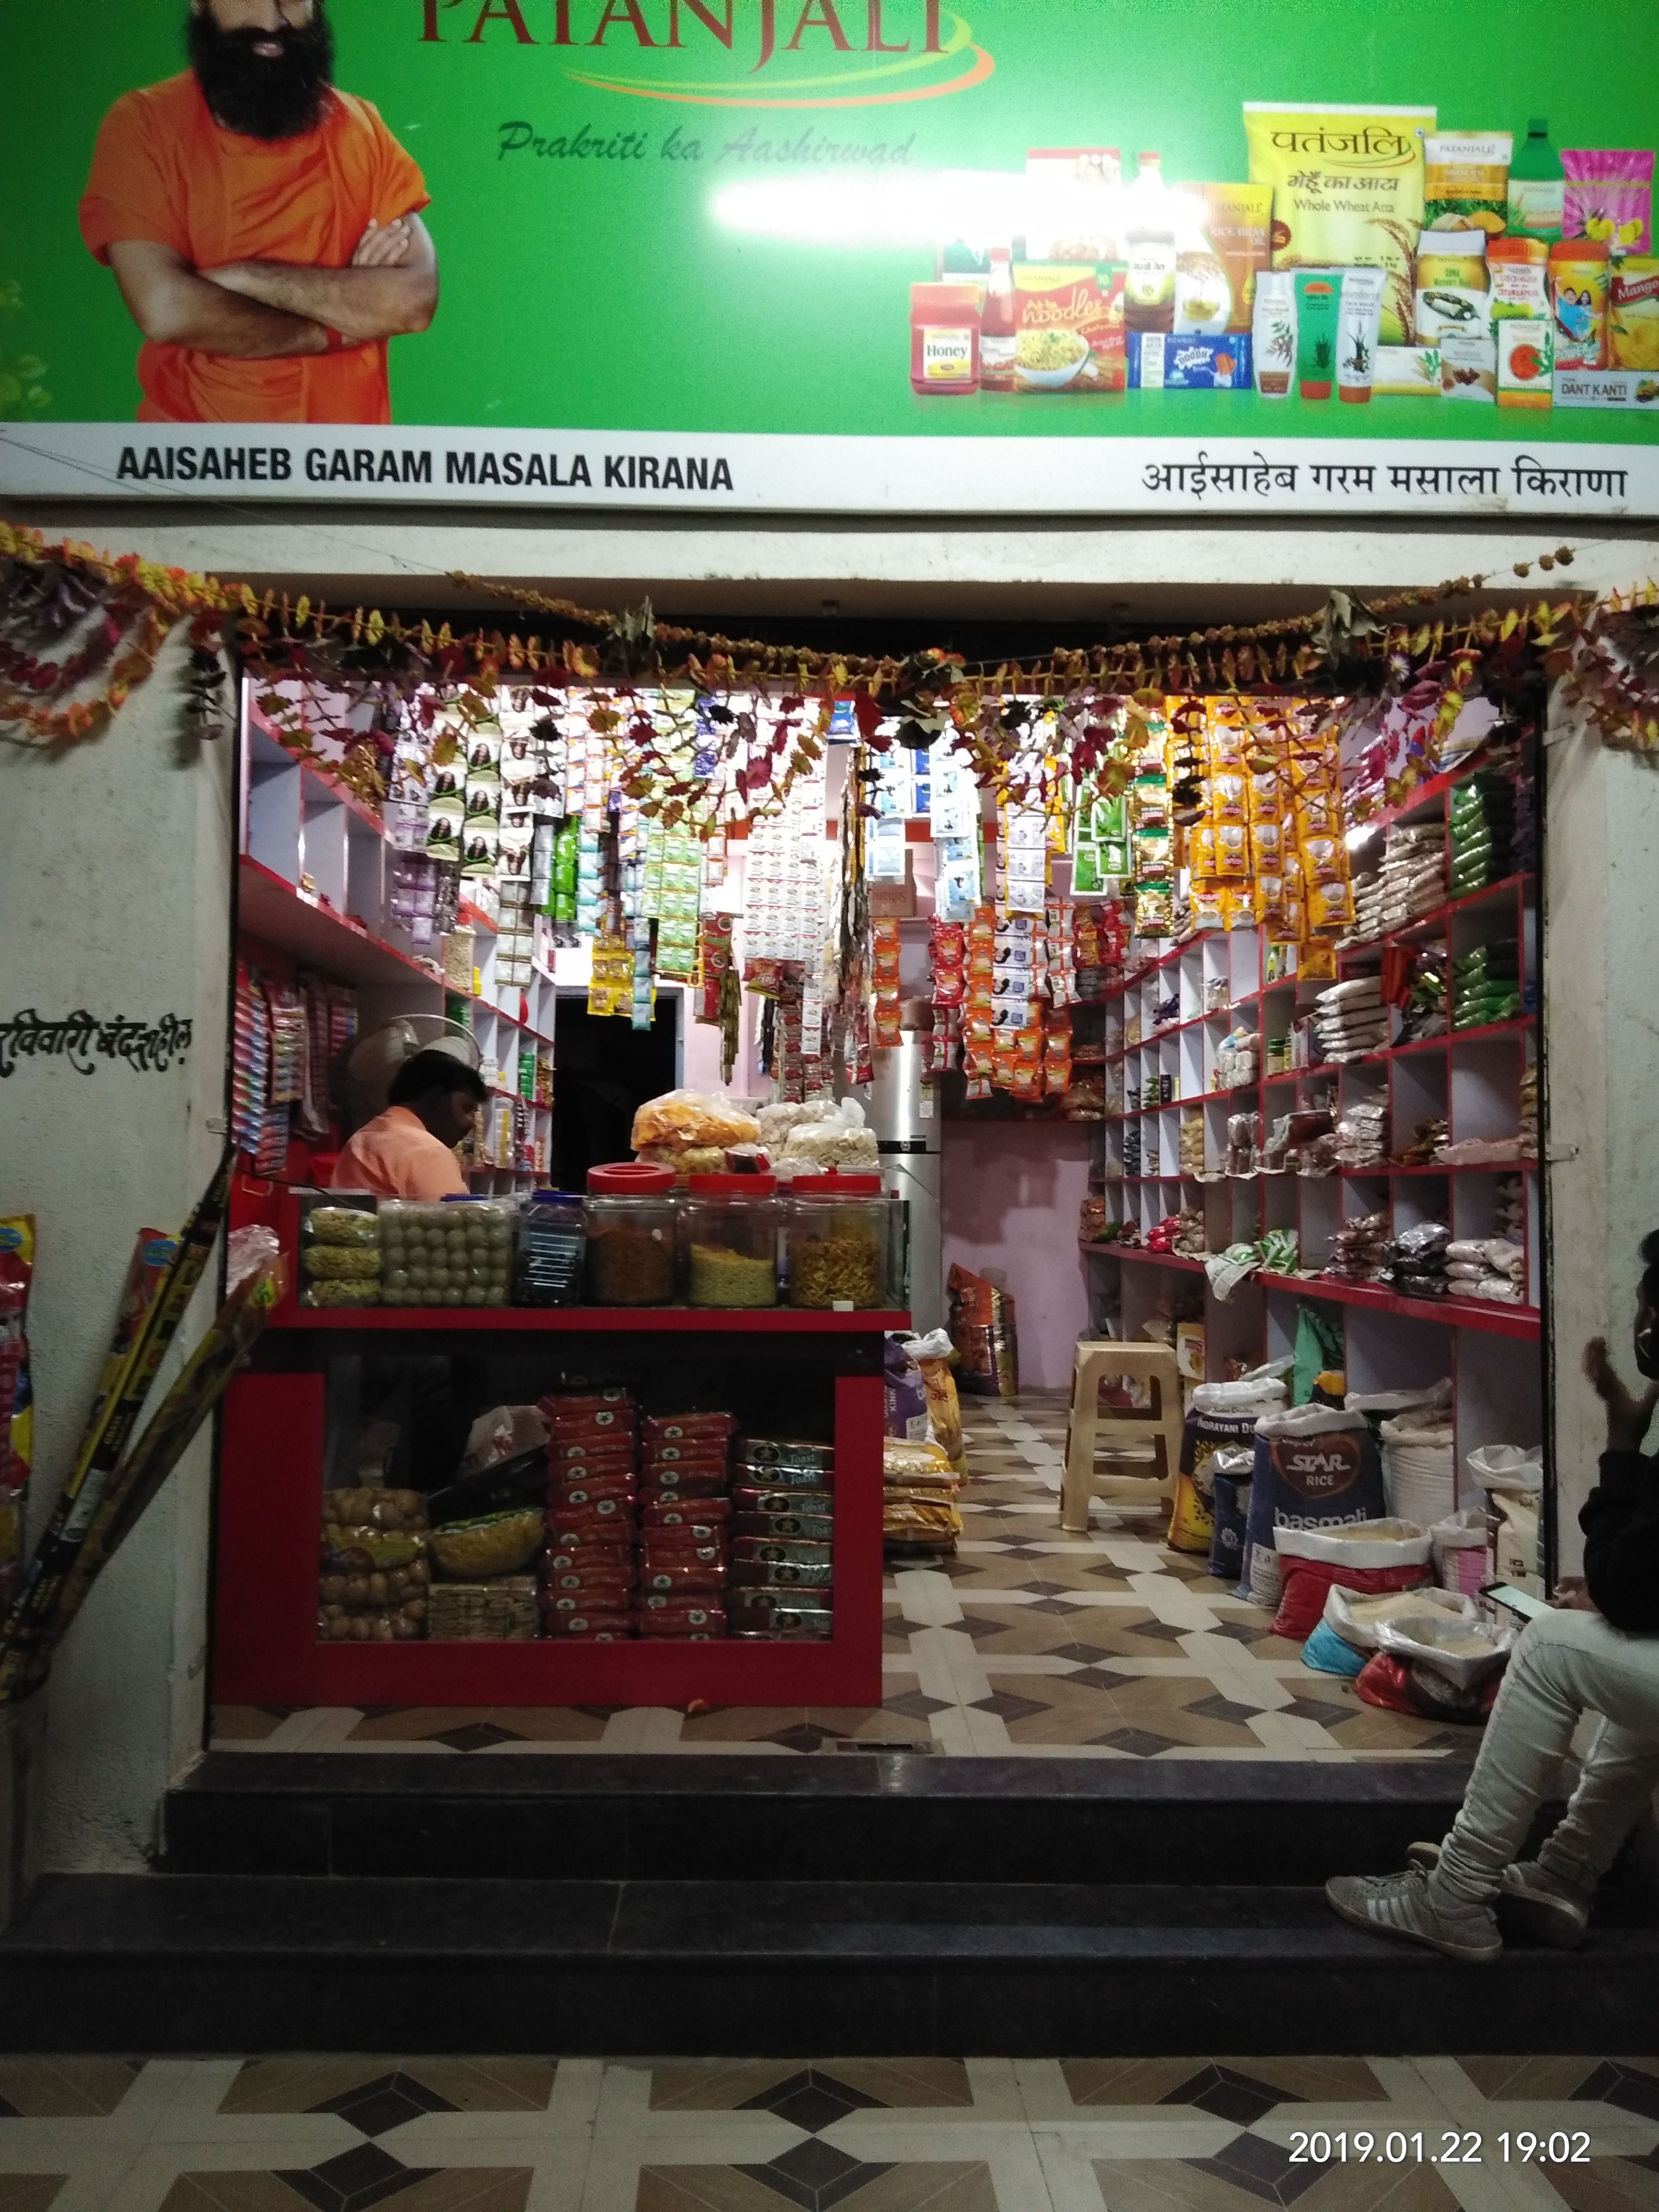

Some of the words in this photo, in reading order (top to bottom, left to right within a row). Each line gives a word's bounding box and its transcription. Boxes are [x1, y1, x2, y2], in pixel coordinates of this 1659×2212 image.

[497, 120, 647, 162] Prakriti
[660, 126, 703, 161] ka
[713, 127, 916, 164] Aashirwad
[1270, 127, 1406, 156] पतंजलि
[1324, 175, 1350, 190] का
[1353, 177, 1400, 191] आटा
[1294, 199, 1331, 212] Whole
[1333, 200, 1369, 213] Wheat
[1372, 201, 1394, 213] Atta
[1022, 287, 1103, 324] noodles
[926, 344, 968, 359] Honey
[1562, 384, 1590, 395] DANT
[1593, 384, 1627, 396] KANTI
[116, 446, 291, 481] AAISAHEB
[305, 447, 432, 483] GARAM
[446, 451, 592, 487] MASALA
[604, 455, 733, 490] KIRANA
[1142, 451, 1298, 500] आईसाहेब
[1310, 465, 1376, 493] गरम
[1387, 465, 1501, 496] मसाला
[1511, 454, 1628, 497] किराणा
[1197, 1419, 1239, 1434] INDRAYANI
[789, 1453, 816, 1464] Toast
[1286, 1452, 1351, 1472] STAR
[1306, 1475, 1334, 1486] RICE
